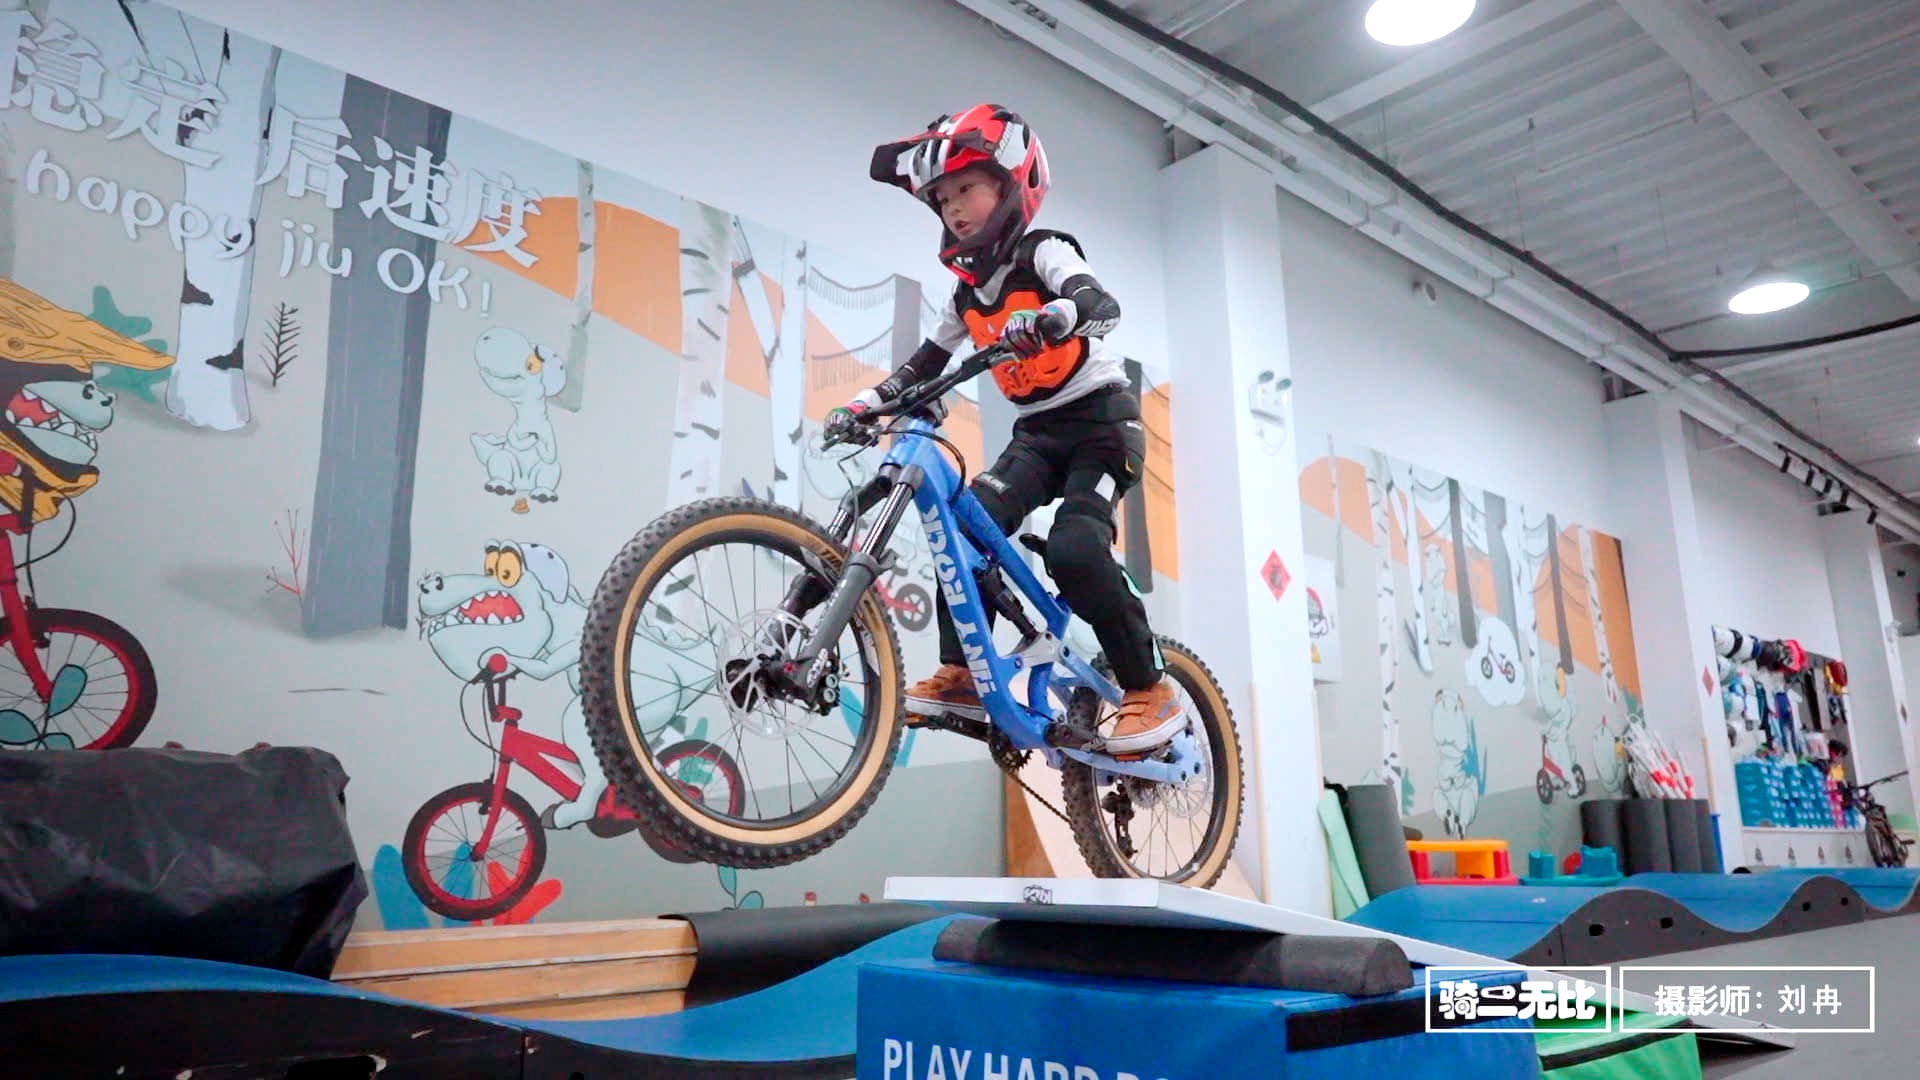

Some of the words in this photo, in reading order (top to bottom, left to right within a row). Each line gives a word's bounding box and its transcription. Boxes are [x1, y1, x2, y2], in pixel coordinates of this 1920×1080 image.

[26, 149, 254, 260] happy
[279, 218, 353, 279] jiu
[922, 504, 968, 606] ROCK
